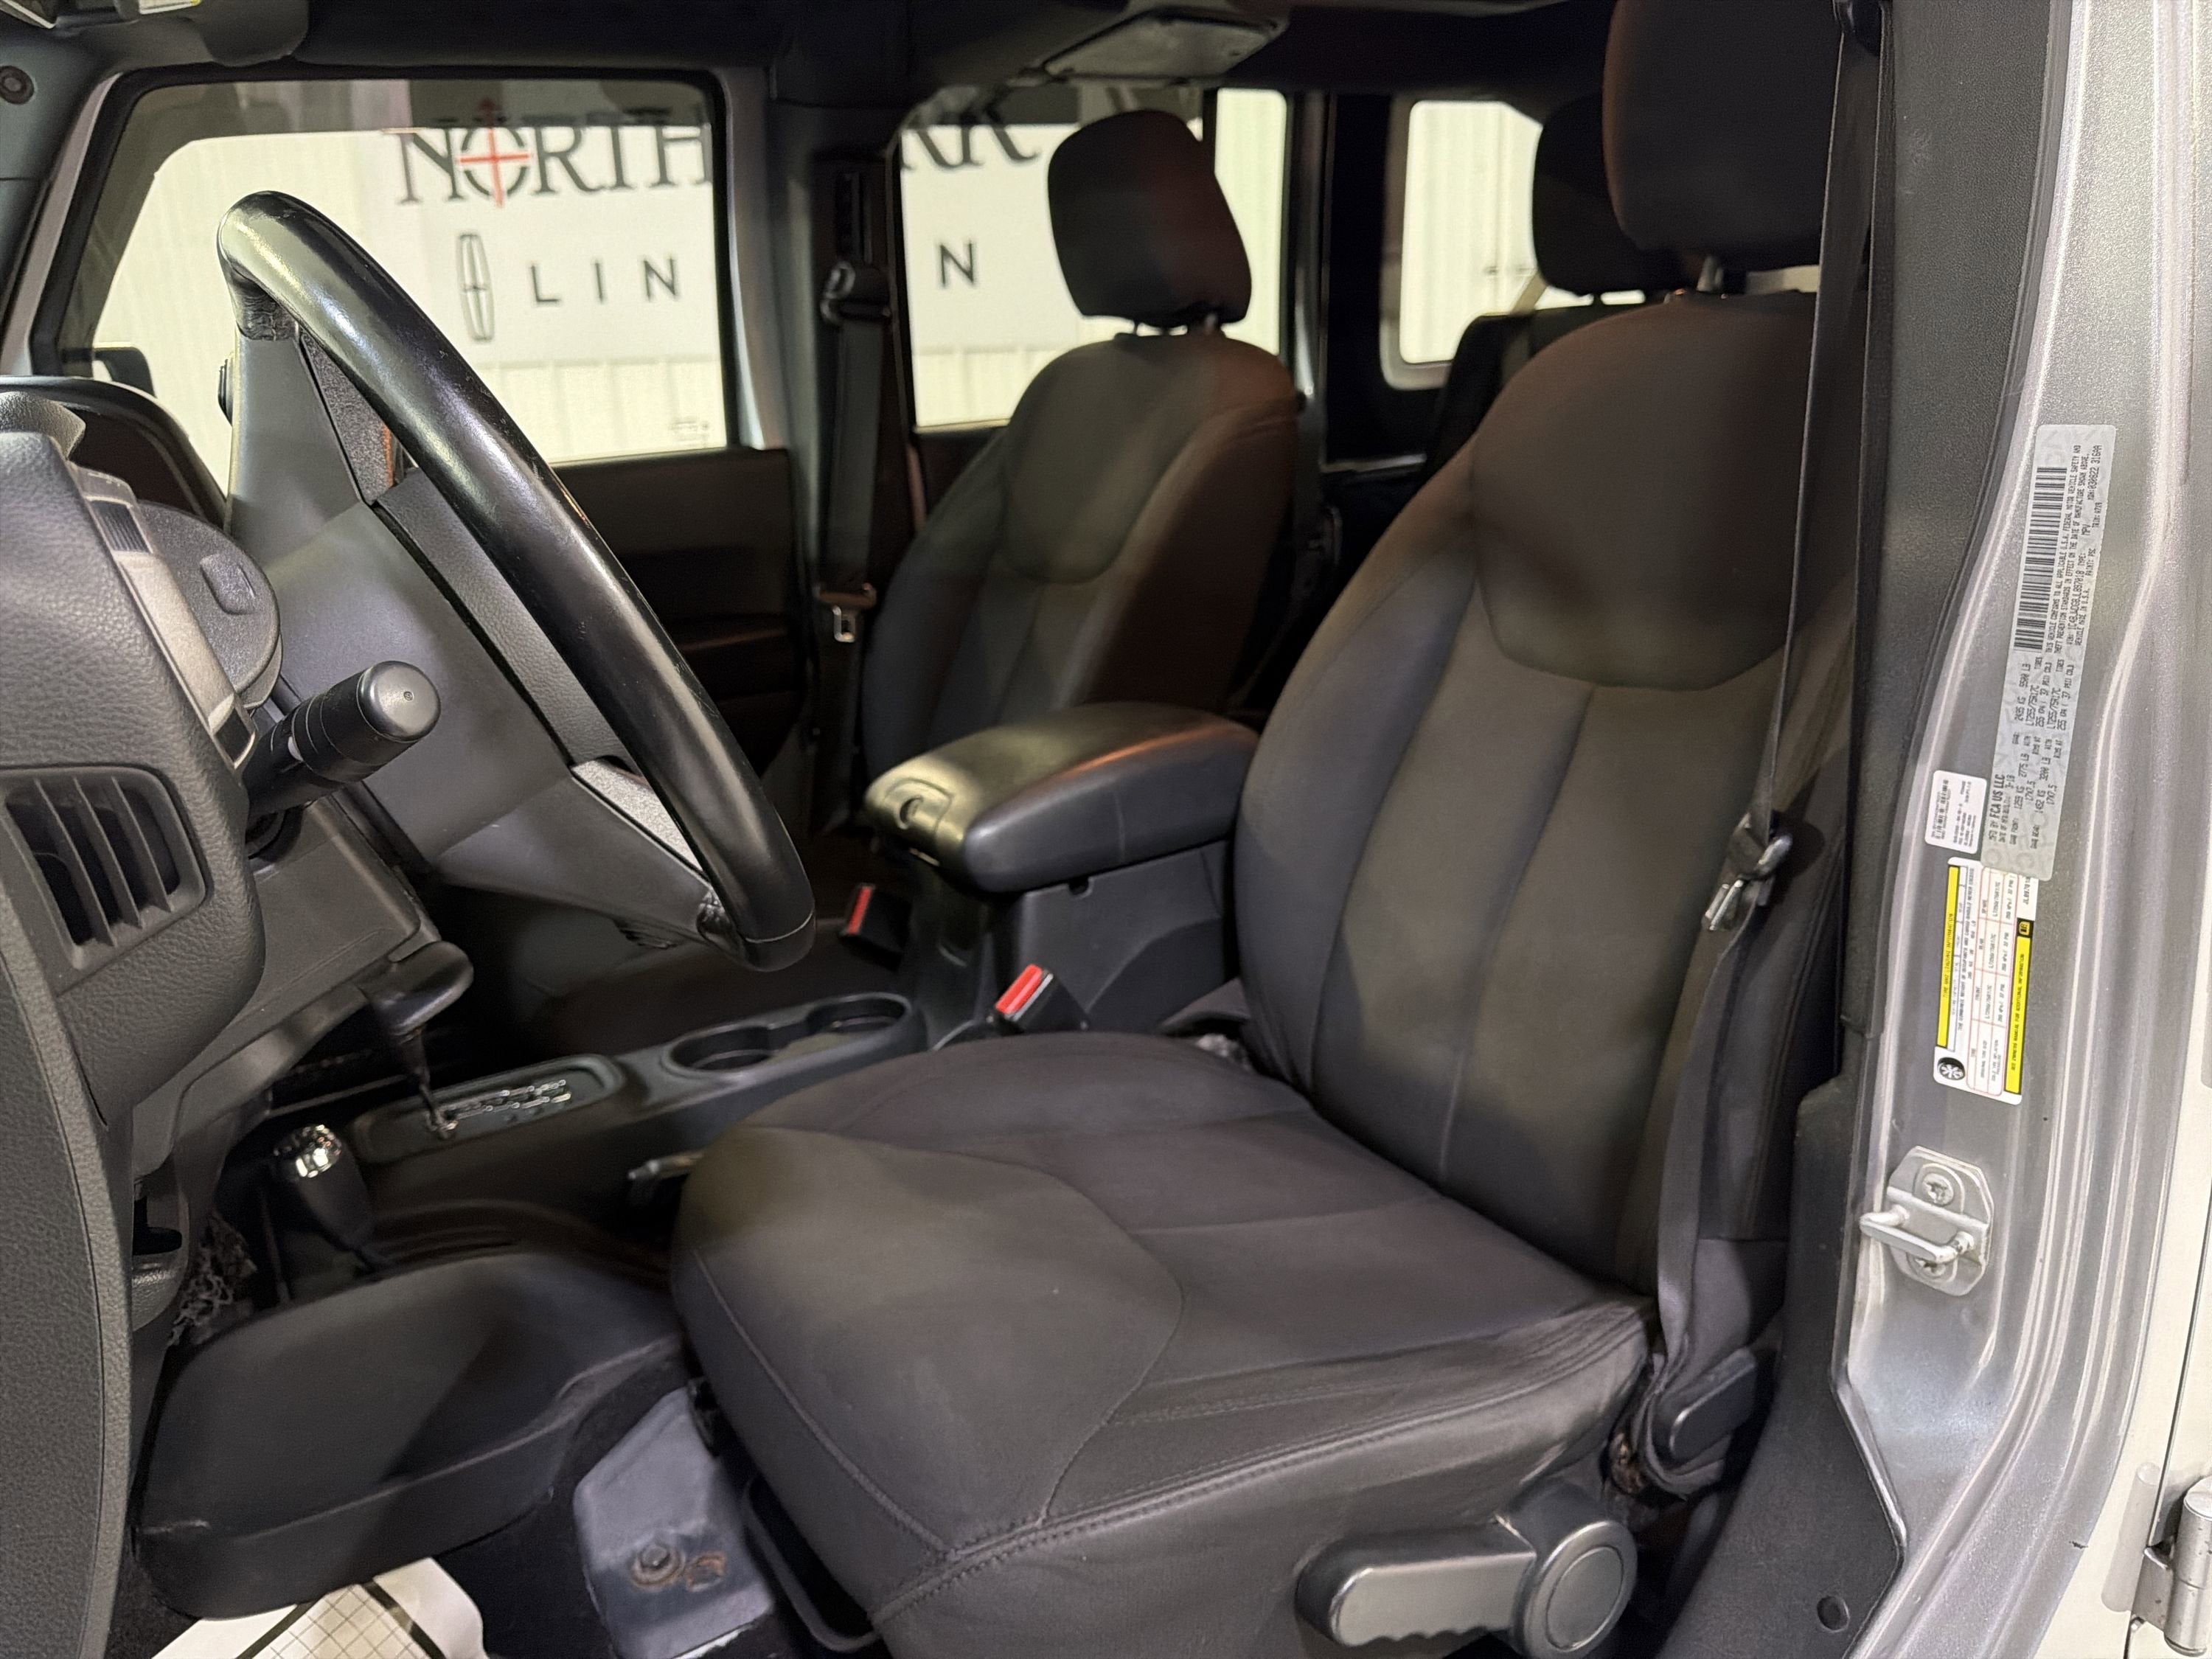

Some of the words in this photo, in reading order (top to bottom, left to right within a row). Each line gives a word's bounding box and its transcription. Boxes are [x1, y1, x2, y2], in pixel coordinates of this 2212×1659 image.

[2081, 524, 2091, 535] MPV
[1993, 773, 2005, 789] LLC
[1992, 789, 2003, 801] US
[1989, 801, 2001, 819] FCA
